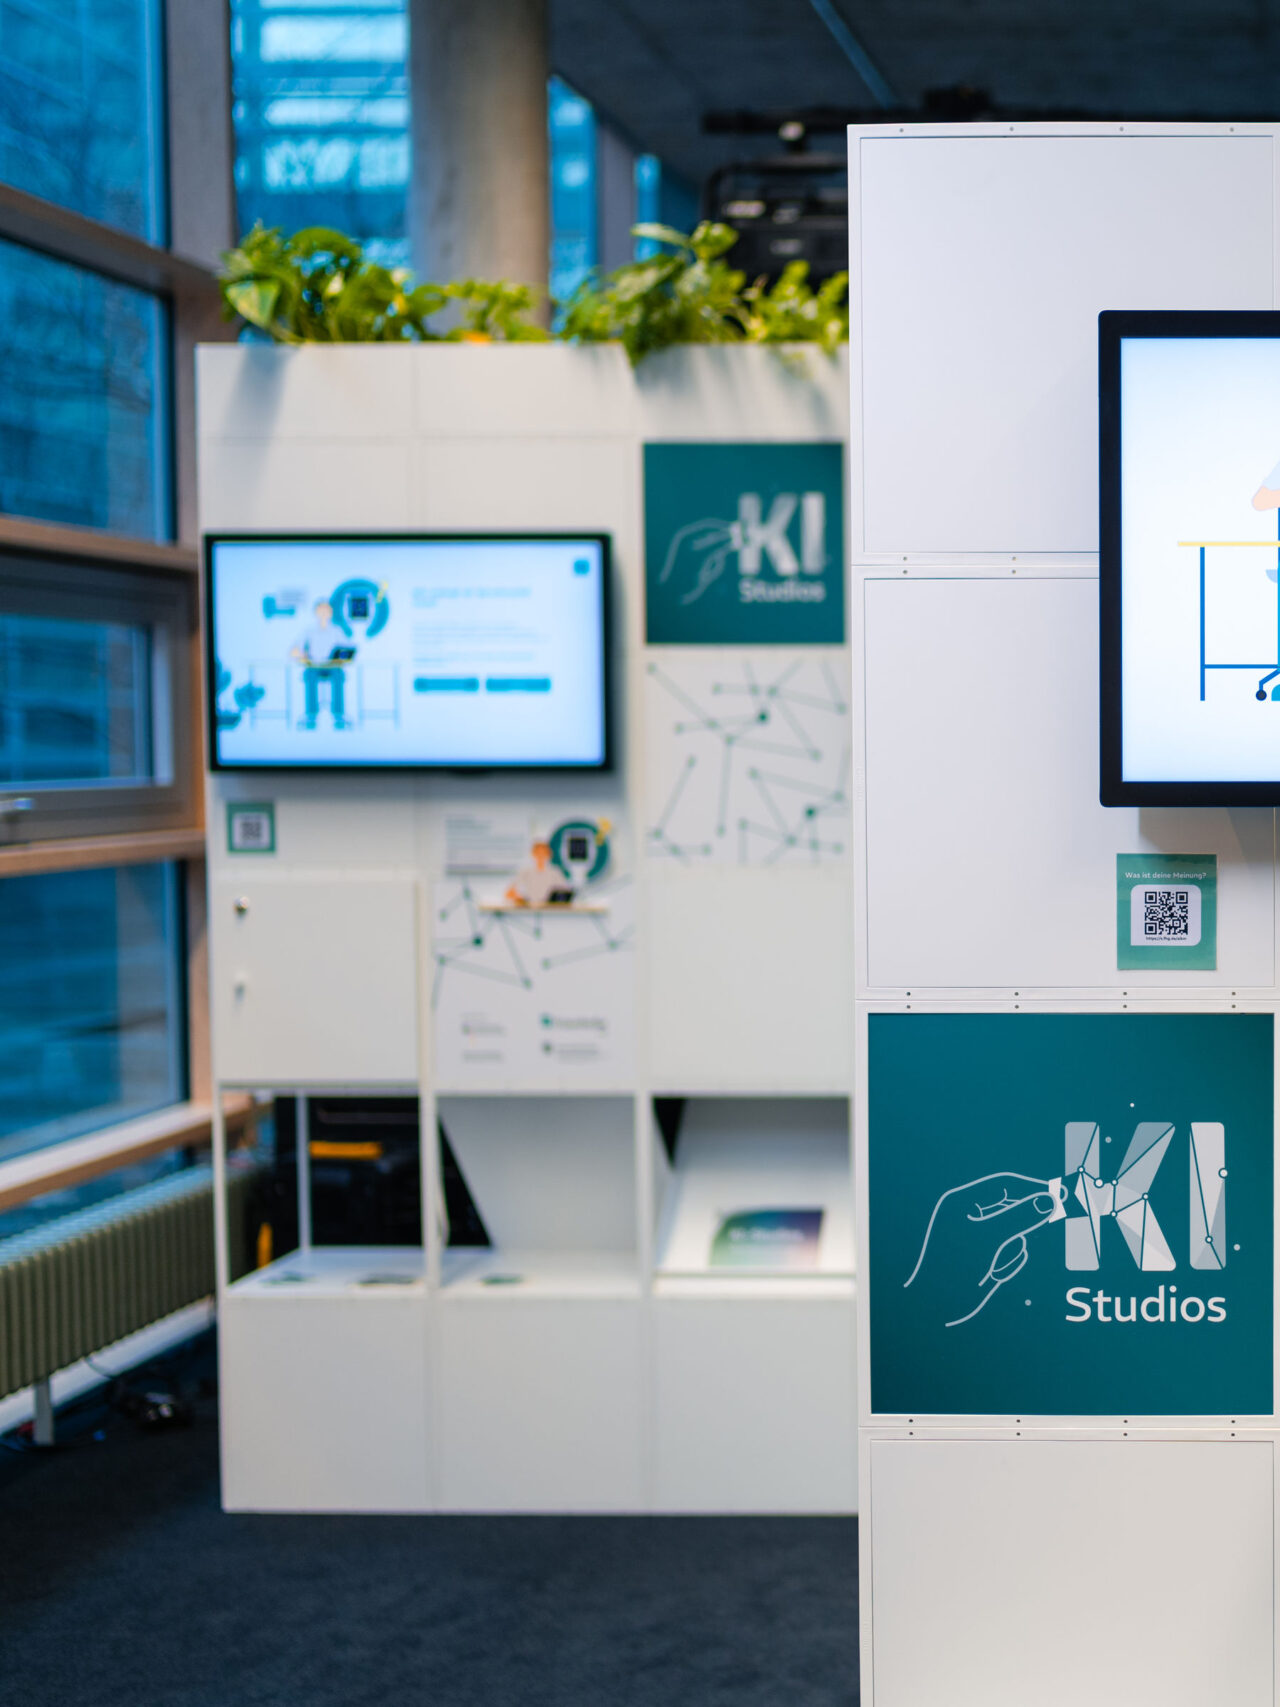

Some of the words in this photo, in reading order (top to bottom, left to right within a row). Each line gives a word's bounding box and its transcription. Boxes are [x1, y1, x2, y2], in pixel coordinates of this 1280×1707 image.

[738, 492, 826, 576] KI
[739, 578, 826, 602] Studios
[1173, 872, 1206, 880] Meinung?
[1065, 1122, 1226, 1271] KI
[1066, 1285, 1226, 1322] Studios
